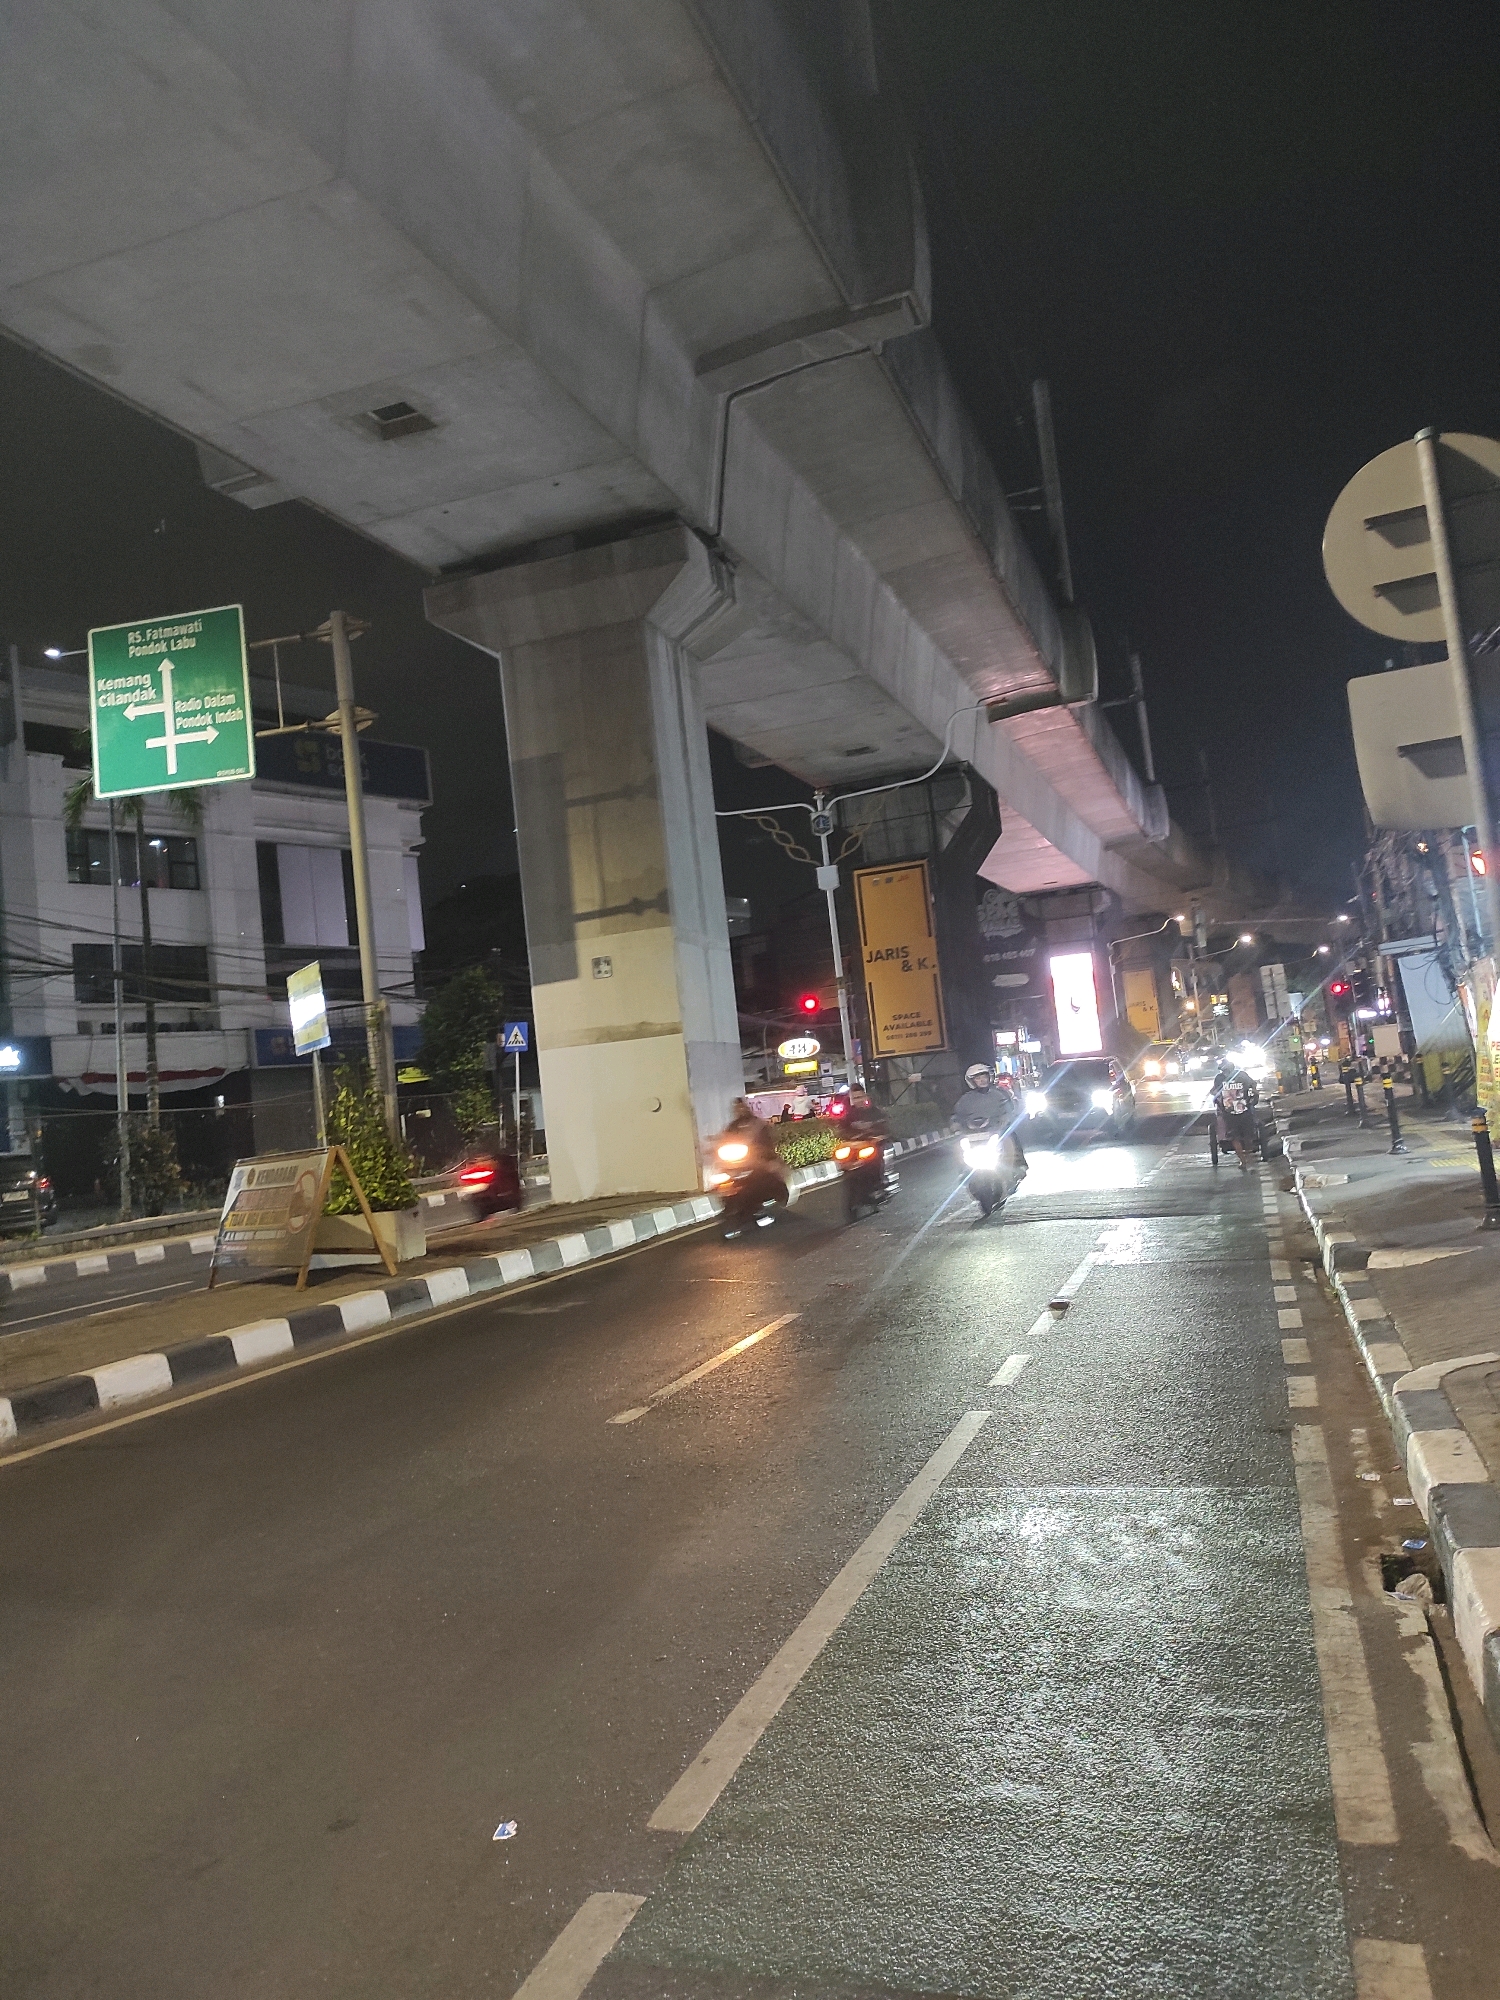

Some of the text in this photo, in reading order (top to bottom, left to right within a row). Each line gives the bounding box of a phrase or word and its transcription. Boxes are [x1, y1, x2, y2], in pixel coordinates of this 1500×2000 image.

[129, 636, 196, 658] Pondok Labu
[97, 673, 151, 691] Kemang
[99, 687, 157, 708] Cilandak
[174, 693, 236, 713] Radio Dalam
[175, 708, 244, 729] Pondok Indah
[866, 946, 910, 964] JARIS
[901, 960, 913, 972] &
[892, 1011, 921, 1021] SPACE
[883, 1019, 933, 1032] AVAILABLE
